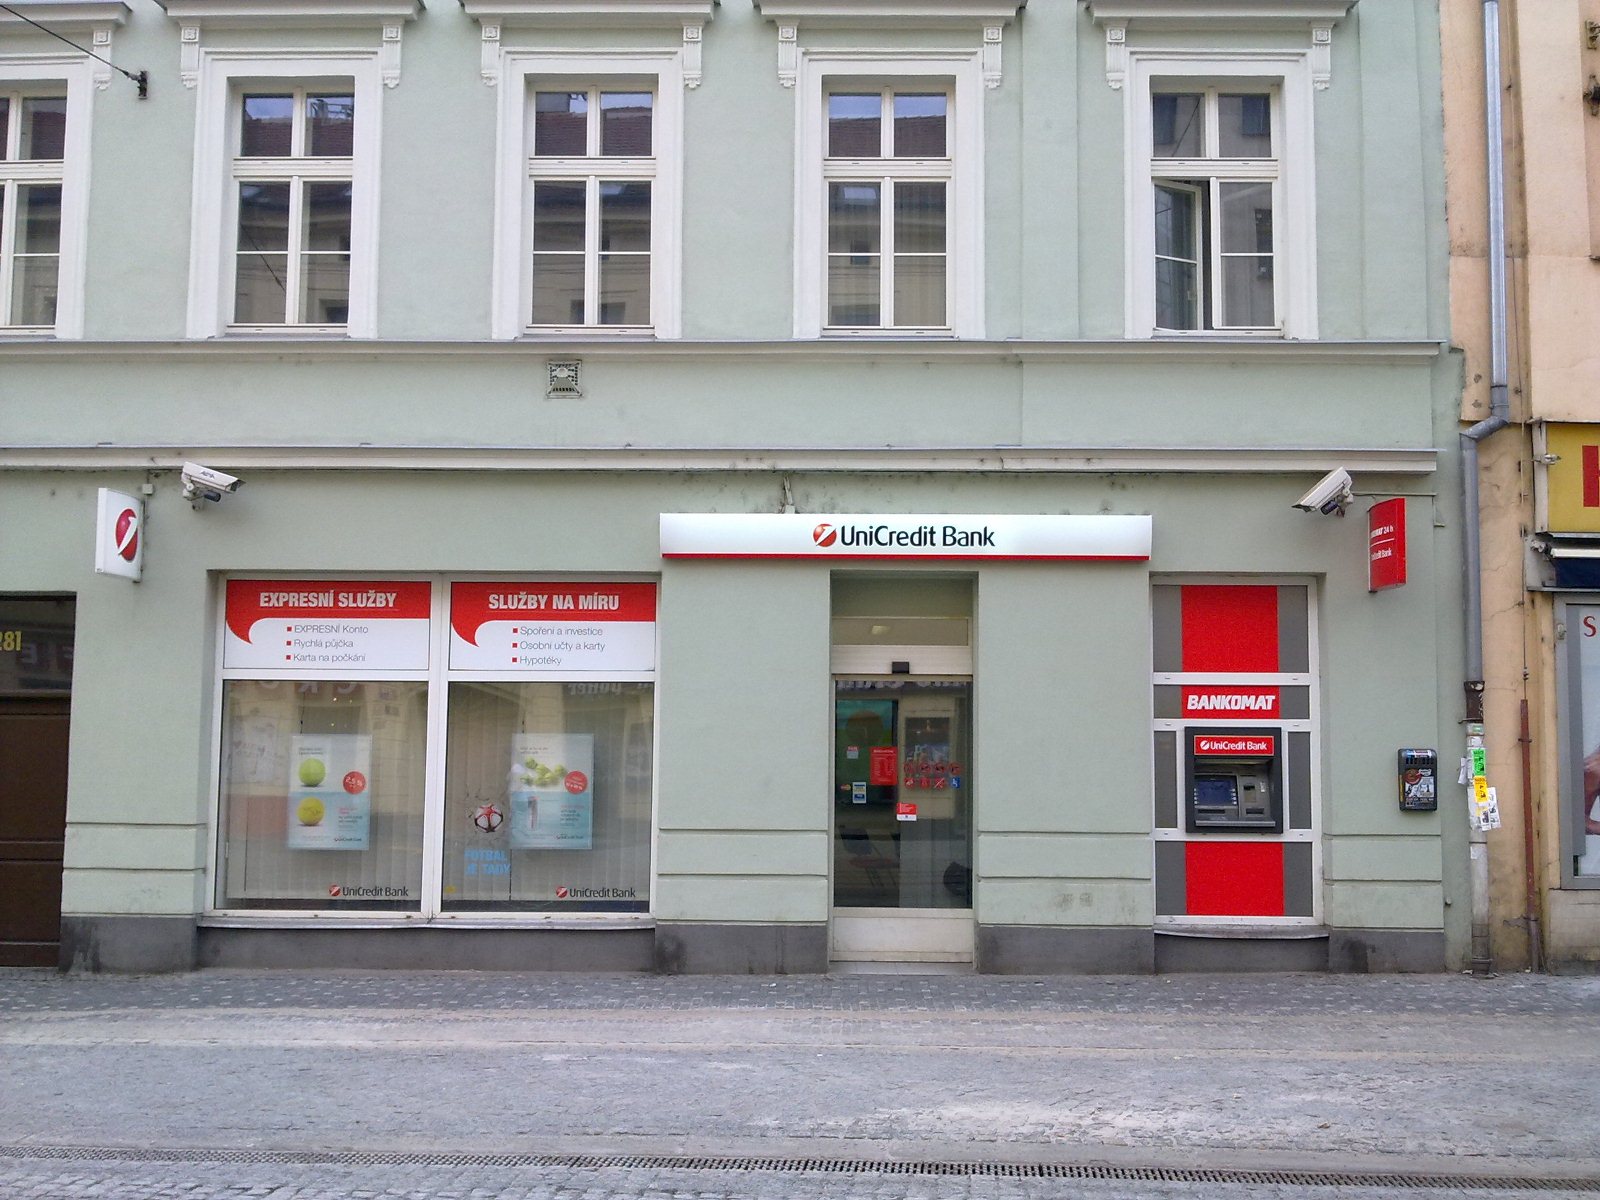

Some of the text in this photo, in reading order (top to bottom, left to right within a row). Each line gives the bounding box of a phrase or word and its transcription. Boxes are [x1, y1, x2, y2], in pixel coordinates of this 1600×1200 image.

[840, 525, 996, 547] UniCredit Bank
[259, 590, 397, 607] EXPRESNÍ SLUŽBY
[489, 592, 620, 610] SLUŽBY NA MÍRU
[294, 624, 369, 634] EXPRESNÍ Konto
[556, 628, 563, 636] a
[564, 626, 603, 636] investice
[0, 631, 21, 651] 81
[583, 641, 606, 652] karty
[293, 653, 317, 662] Karta
[318, 654, 330, 662] na
[519, 655, 562, 667] Hypotéky
[1187, 695, 1275, 709] BANKOMAT
[1210, 741, 1267, 750] UniCredit Bank
[342, 885, 409, 897] UniCredit Bank
[569, 887, 637, 898] UniCredit Bank
